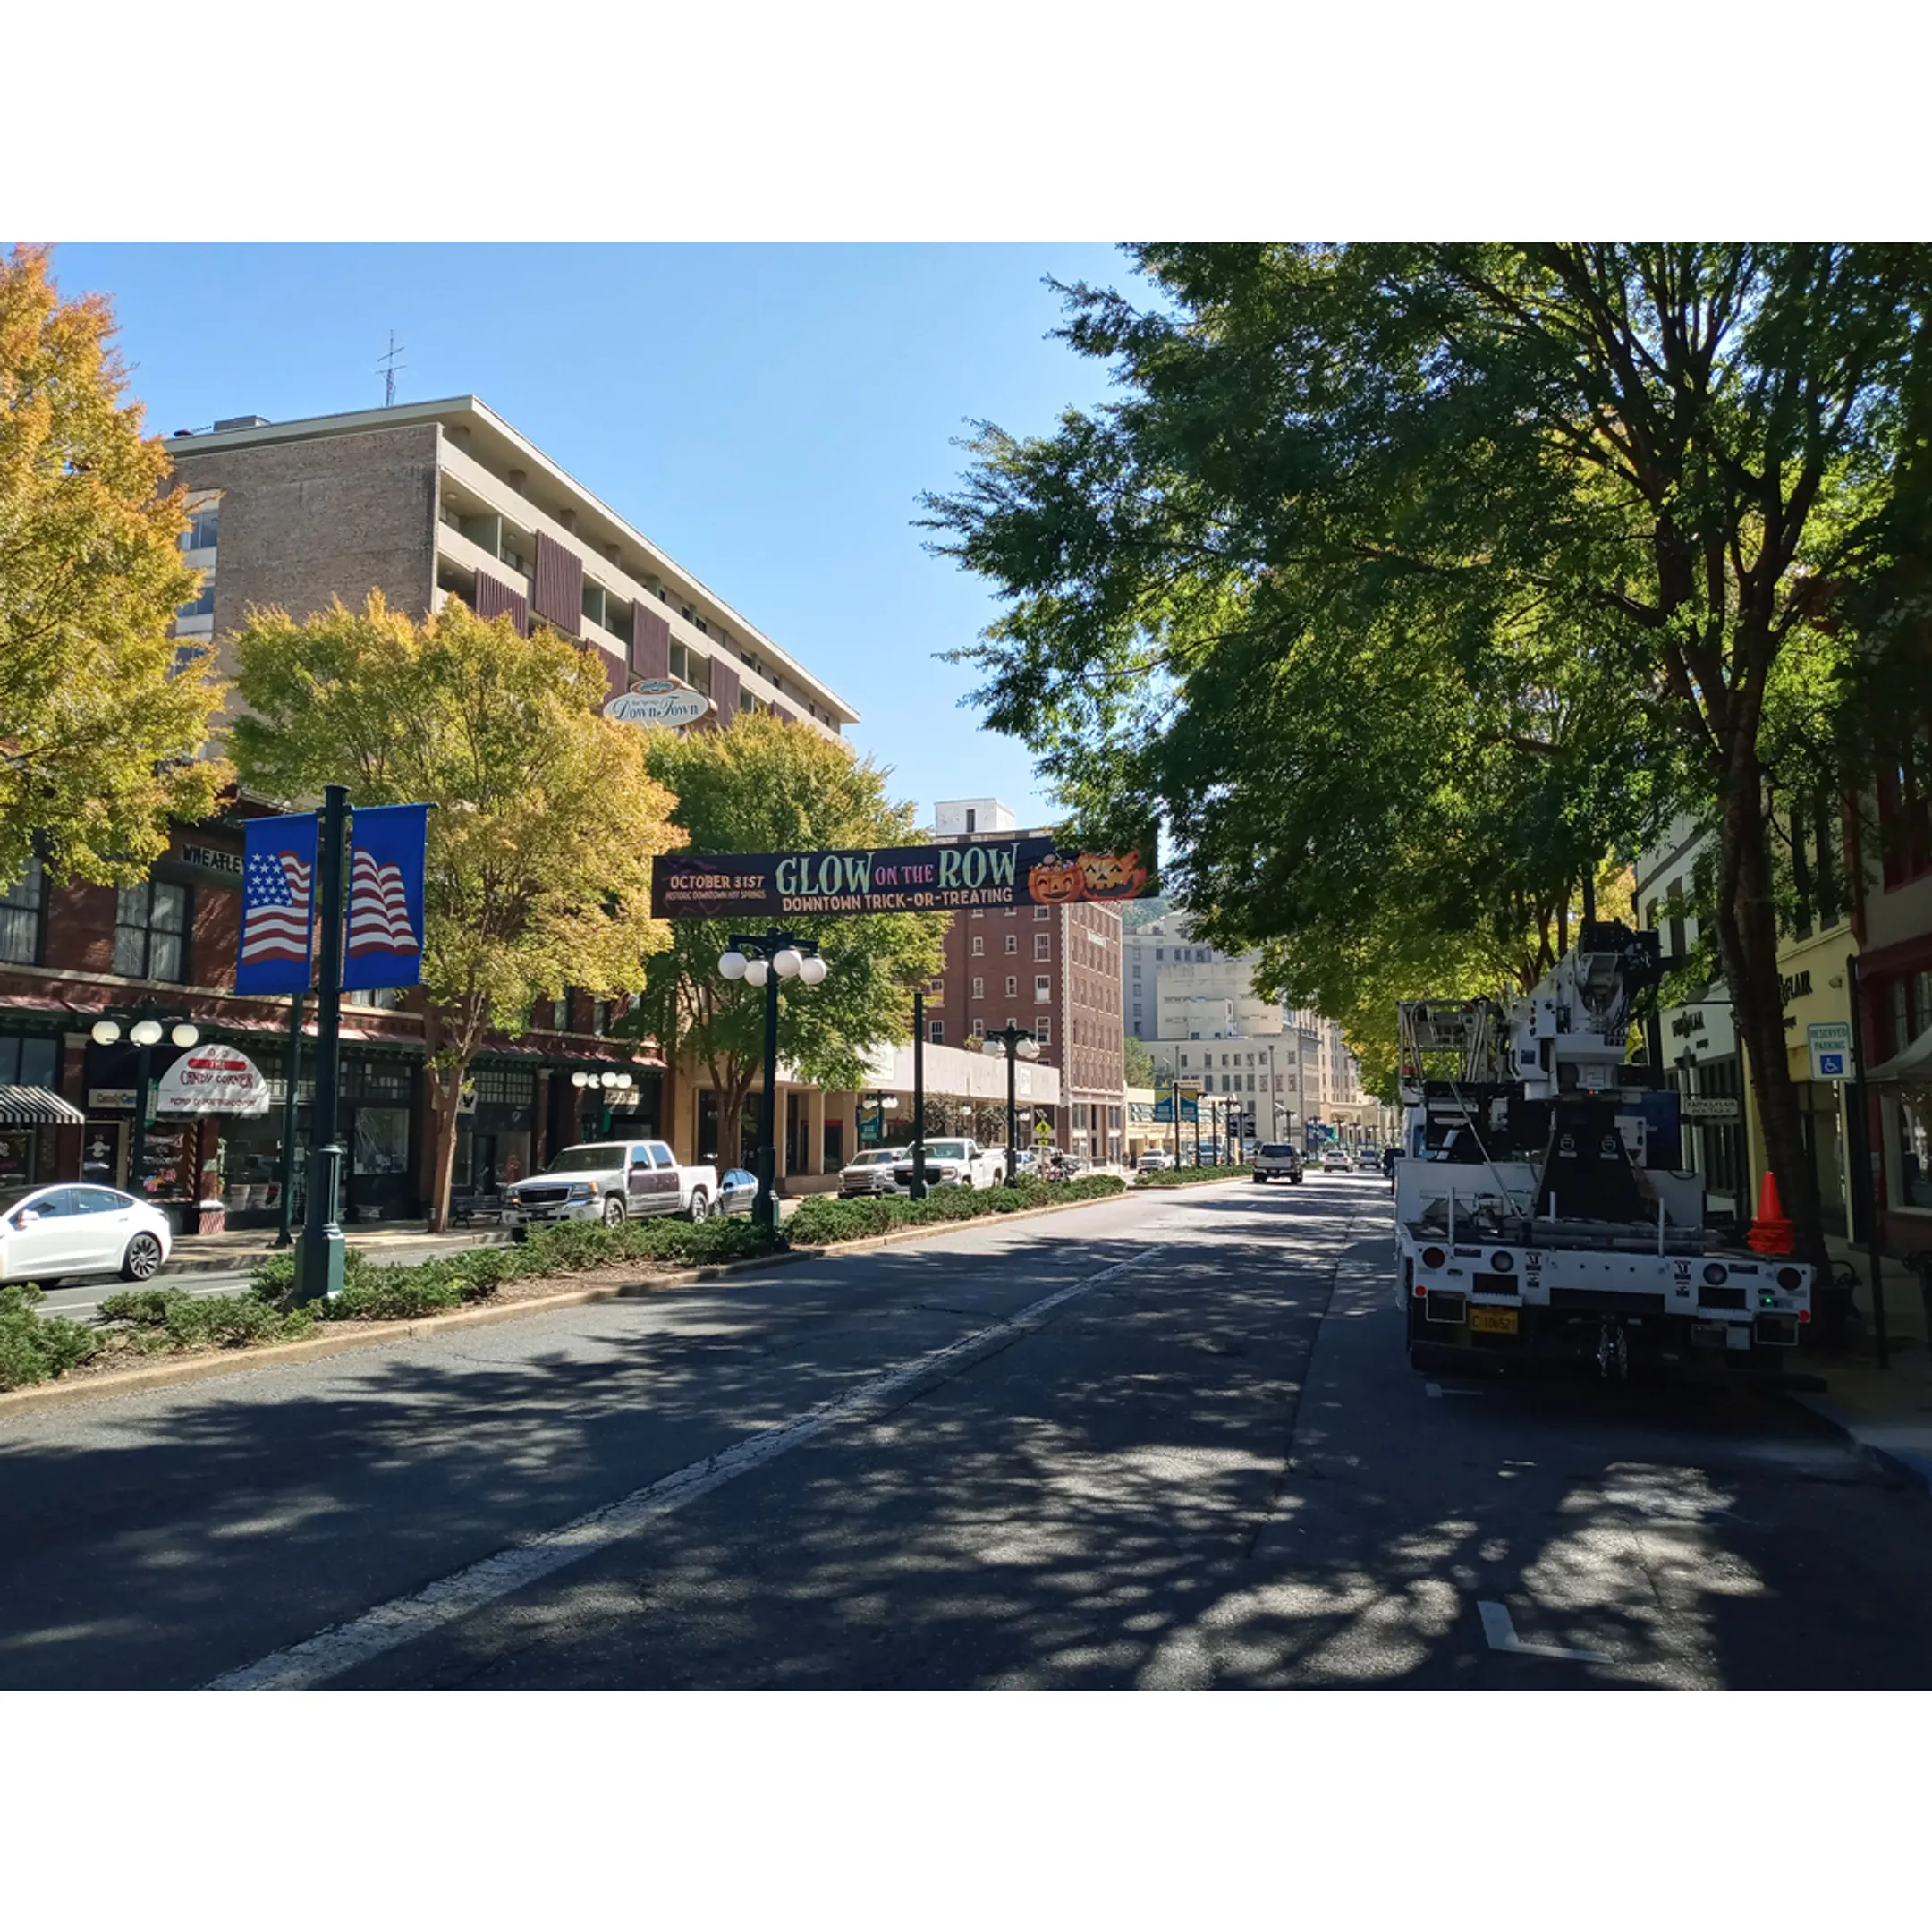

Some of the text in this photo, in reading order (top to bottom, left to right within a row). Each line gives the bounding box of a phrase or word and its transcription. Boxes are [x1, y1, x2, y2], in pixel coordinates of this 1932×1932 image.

[775, 842, 1021, 895] GLOW ON THE ROW
[670, 874, 766, 889] OCTOBER 31ST
[782, 887, 1013, 911] DOWNTOWN TRICK-OR-TREATING
[1815, 1041, 1845, 1050] PARKING
[216, 1072, 253, 1089] CORNER
